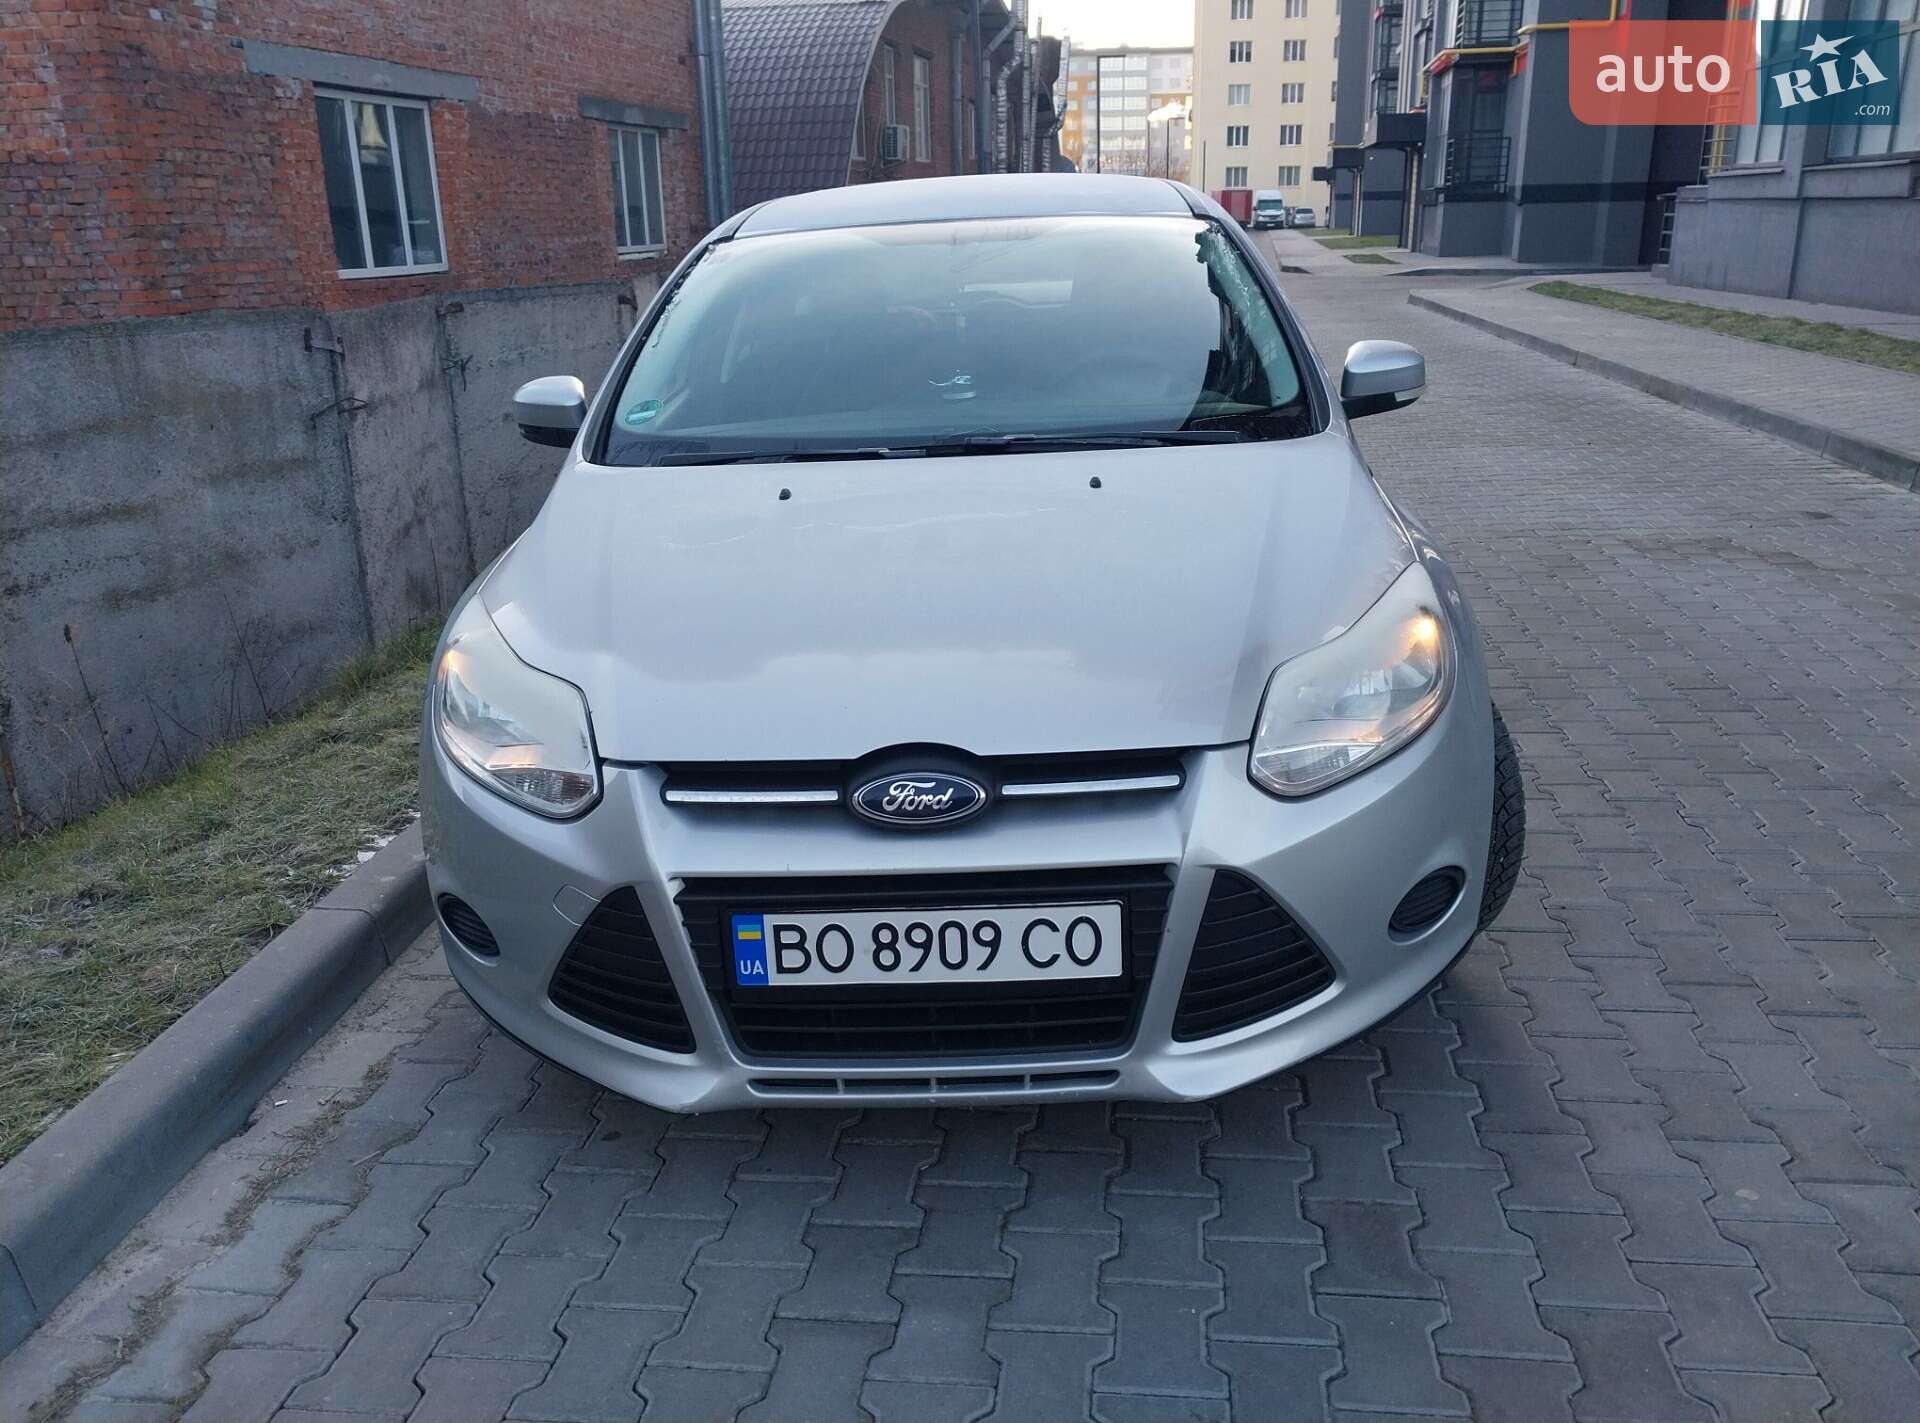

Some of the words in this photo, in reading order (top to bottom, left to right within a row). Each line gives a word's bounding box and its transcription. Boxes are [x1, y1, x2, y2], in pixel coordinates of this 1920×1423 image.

[882, 781, 954, 811] Ford
[772, 922, 855, 974] BO
[871, 919, 1002, 973] 8909
[1021, 915, 1103, 969] CO
[739, 960, 765, 976] UA
